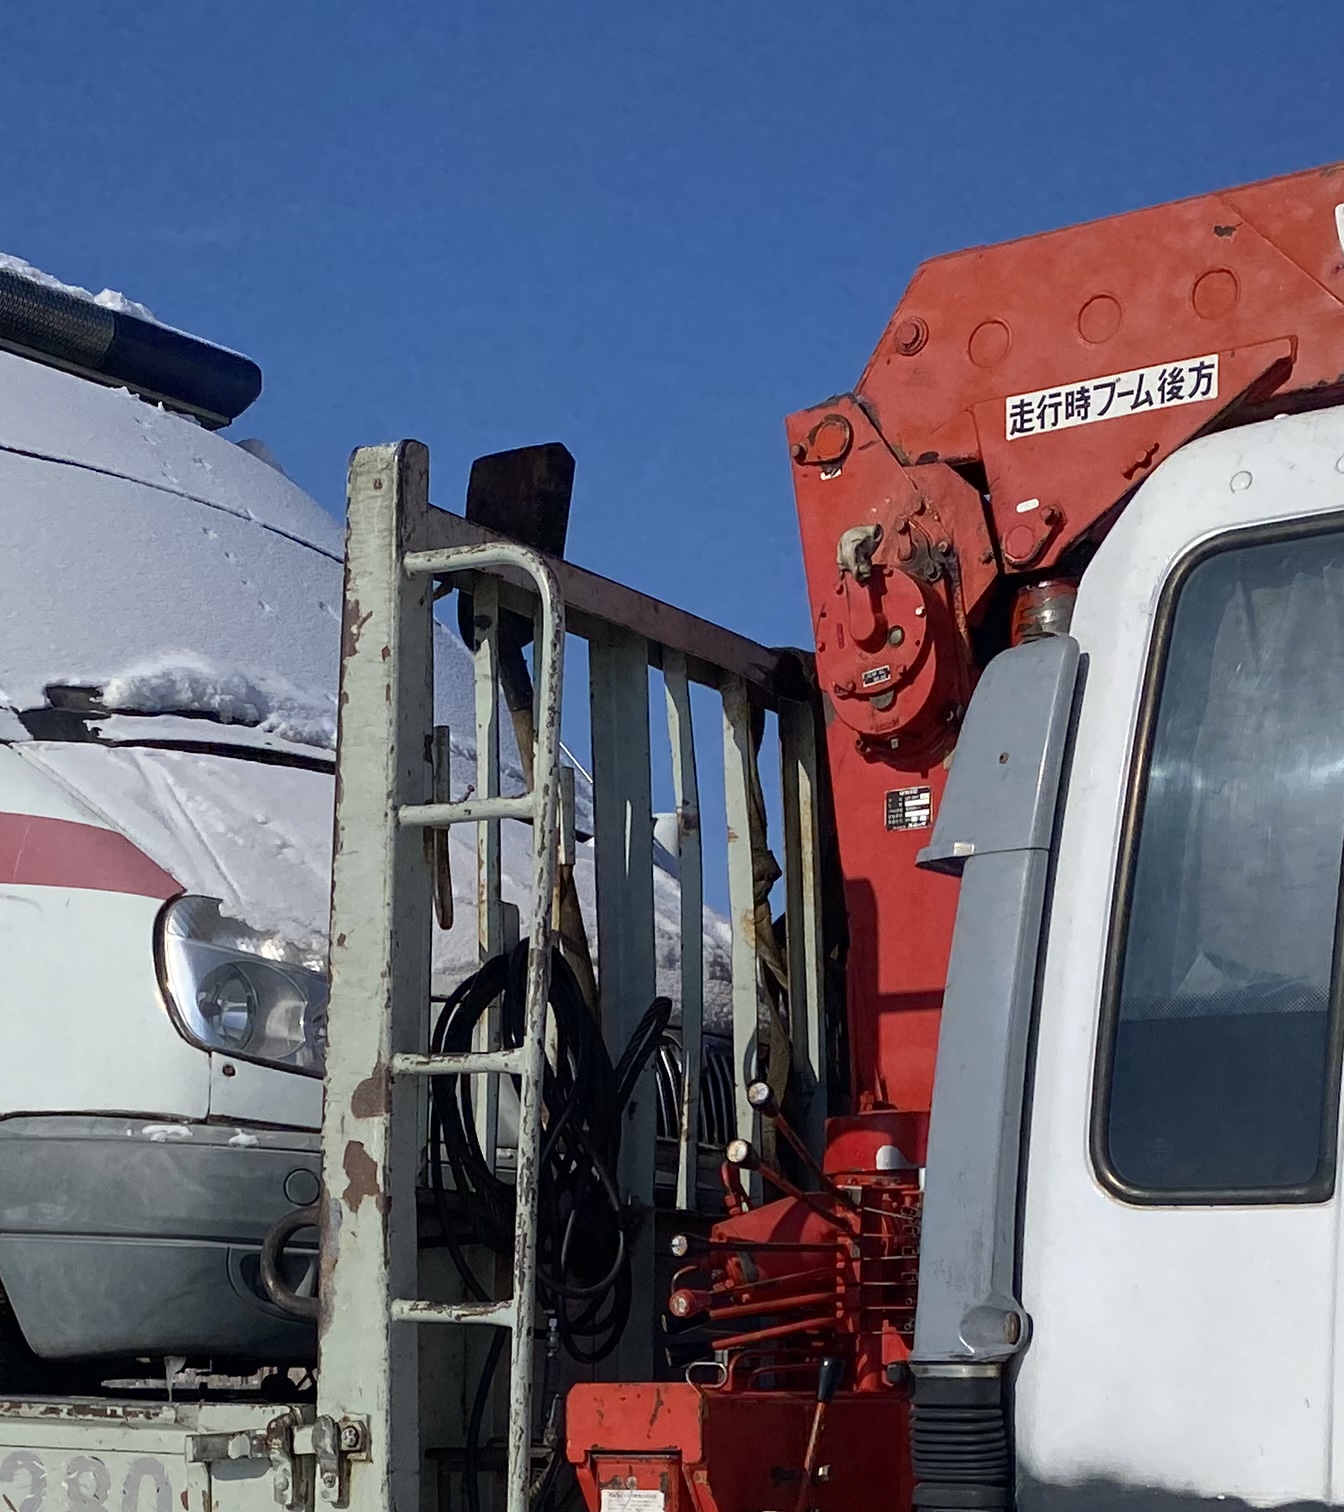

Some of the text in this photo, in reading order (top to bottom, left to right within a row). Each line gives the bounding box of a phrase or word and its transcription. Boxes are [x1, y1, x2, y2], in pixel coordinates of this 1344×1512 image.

[1009, 360, 1216, 437] 走行時ブーム後方
